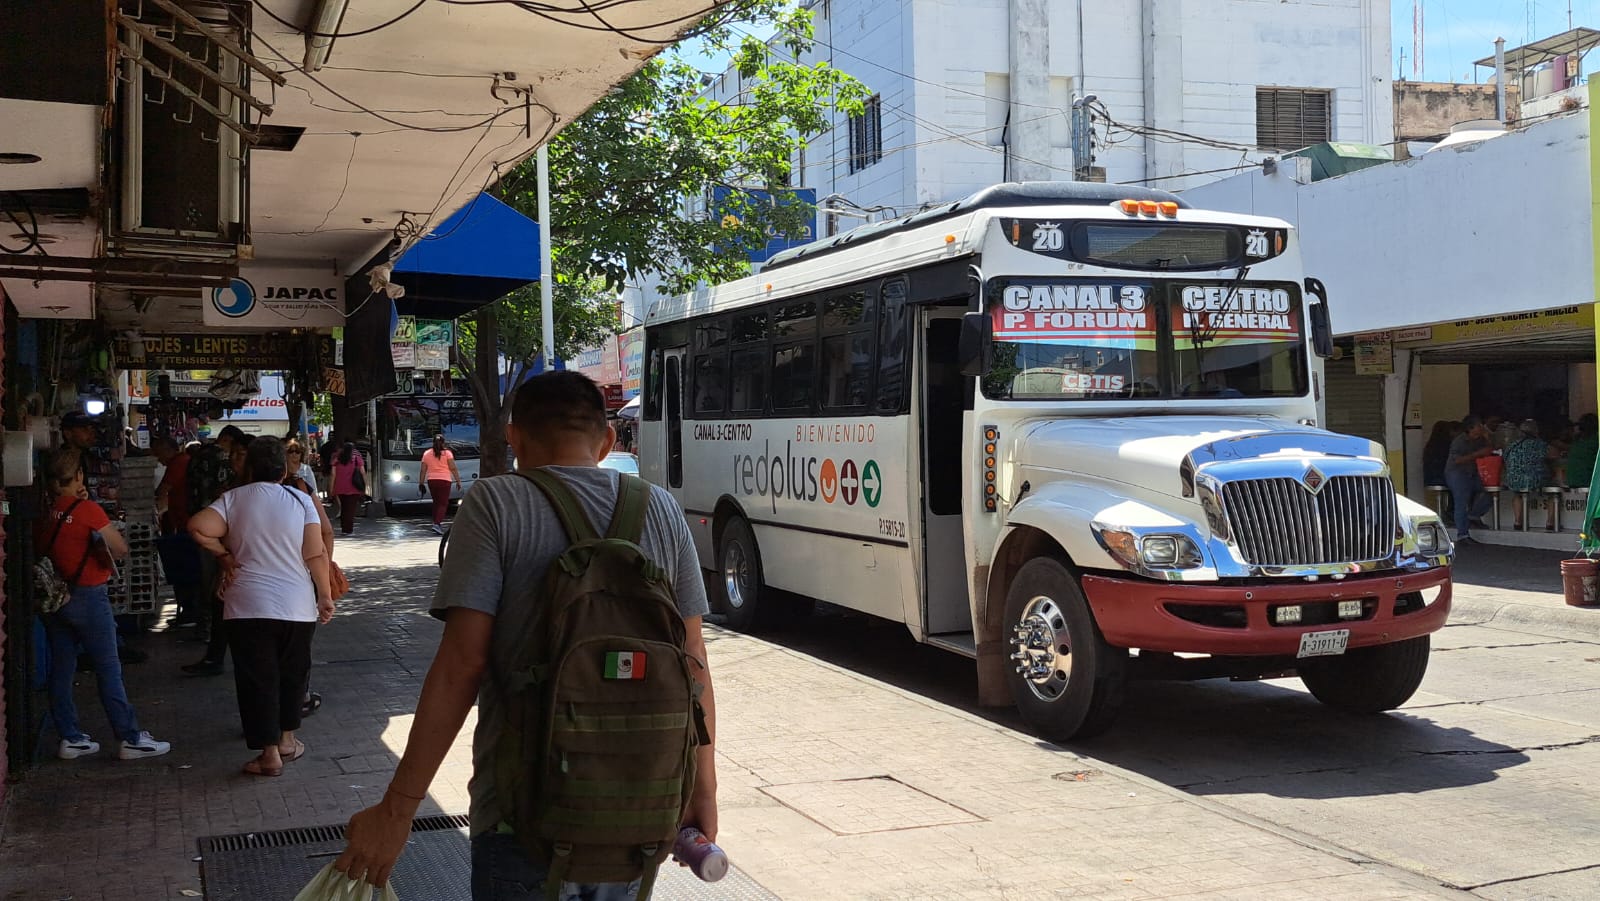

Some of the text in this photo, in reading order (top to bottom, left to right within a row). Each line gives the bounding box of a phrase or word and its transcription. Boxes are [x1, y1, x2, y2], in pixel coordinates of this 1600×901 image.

[1032, 228, 1065, 252] 20
[1246, 233, 1269, 258] 20
[263, 286, 337, 300] JAPAC
[1003, 285, 1146, 312] CANAL 3
[1181, 285, 1291, 314] CENTRO
[1003, 312, 1147, 329] P. FORUM
[1208, 313, 1291, 330] GENERAL
[118, 337, 182, 354] ROJES
[194, 337, 247, 354] LENTES
[1063, 373, 1124, 390] CBTIS
[694, 423, 752, 441] CANAL 3-CENTRO
[796, 423, 875, 443] BIENVENIDO
[734, 438, 818, 515] redplus
[1300, 636, 1347, 652] A-31911-U
